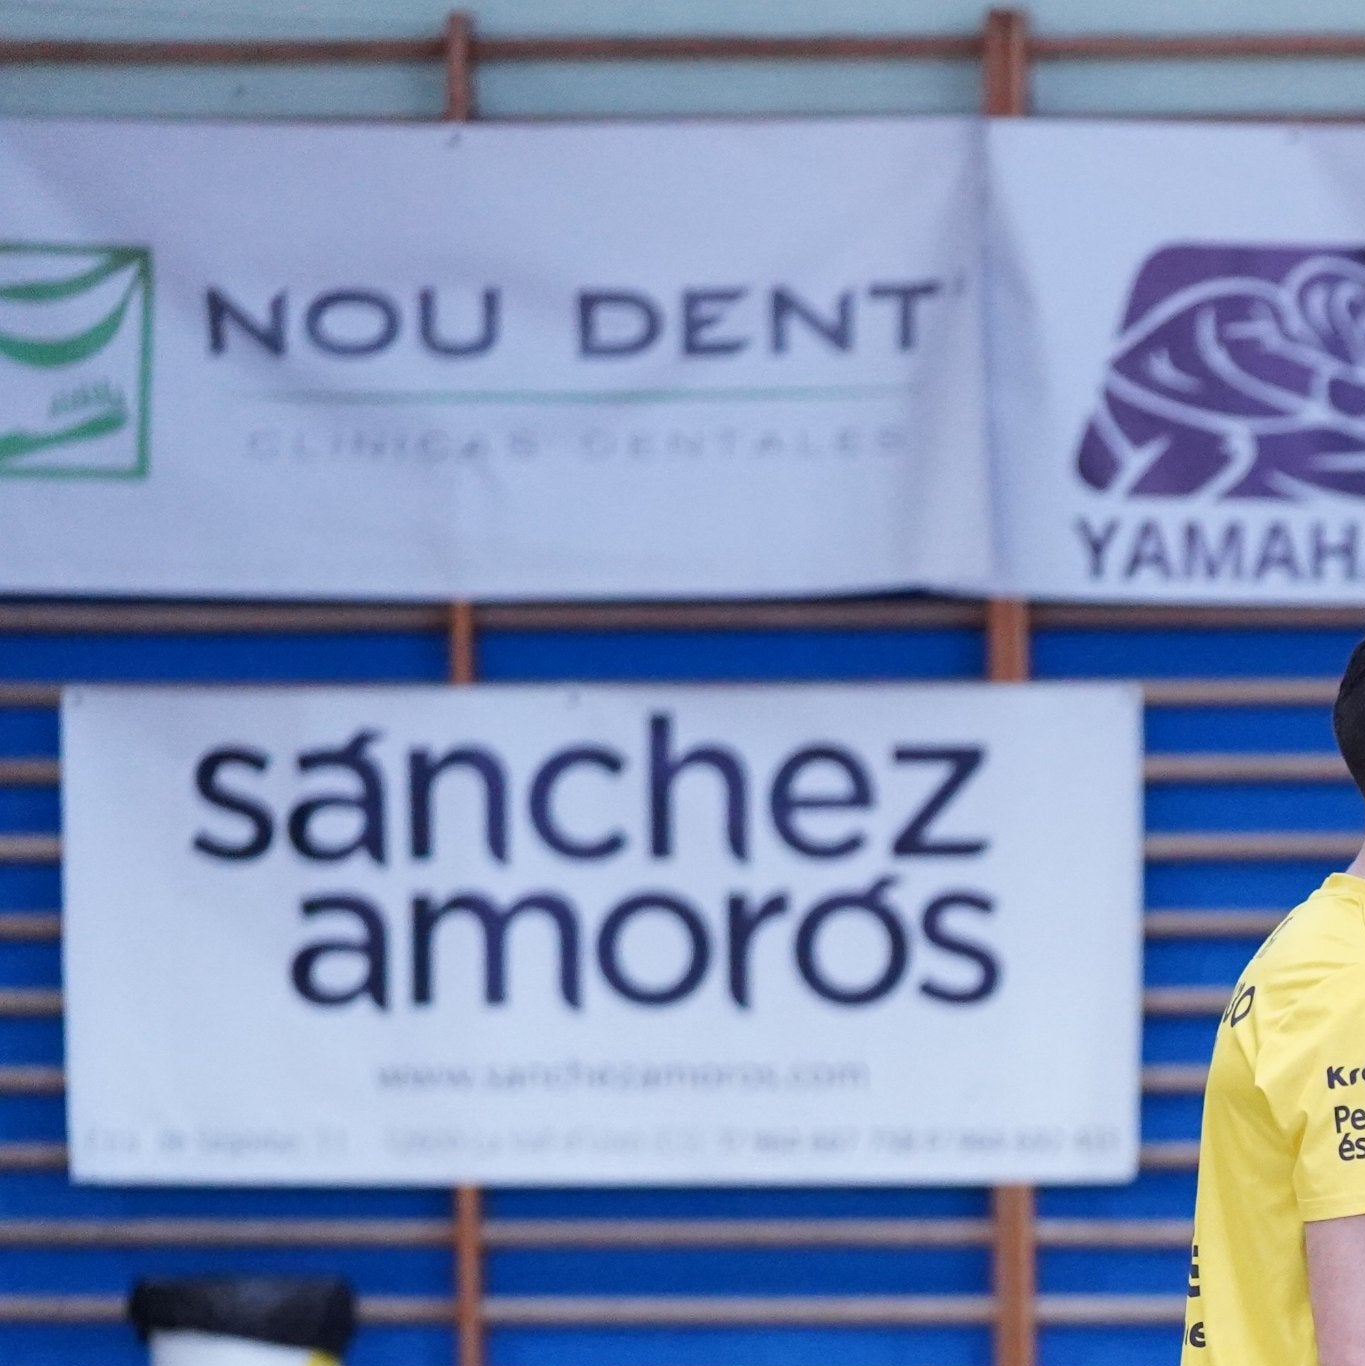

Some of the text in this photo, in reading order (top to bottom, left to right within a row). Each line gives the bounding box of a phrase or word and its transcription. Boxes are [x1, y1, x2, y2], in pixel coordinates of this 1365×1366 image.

[205, 280, 944, 361] NOU DENT
[190, 711, 992, 868] sánchez
[286, 875, 1005, 1016] amorós
